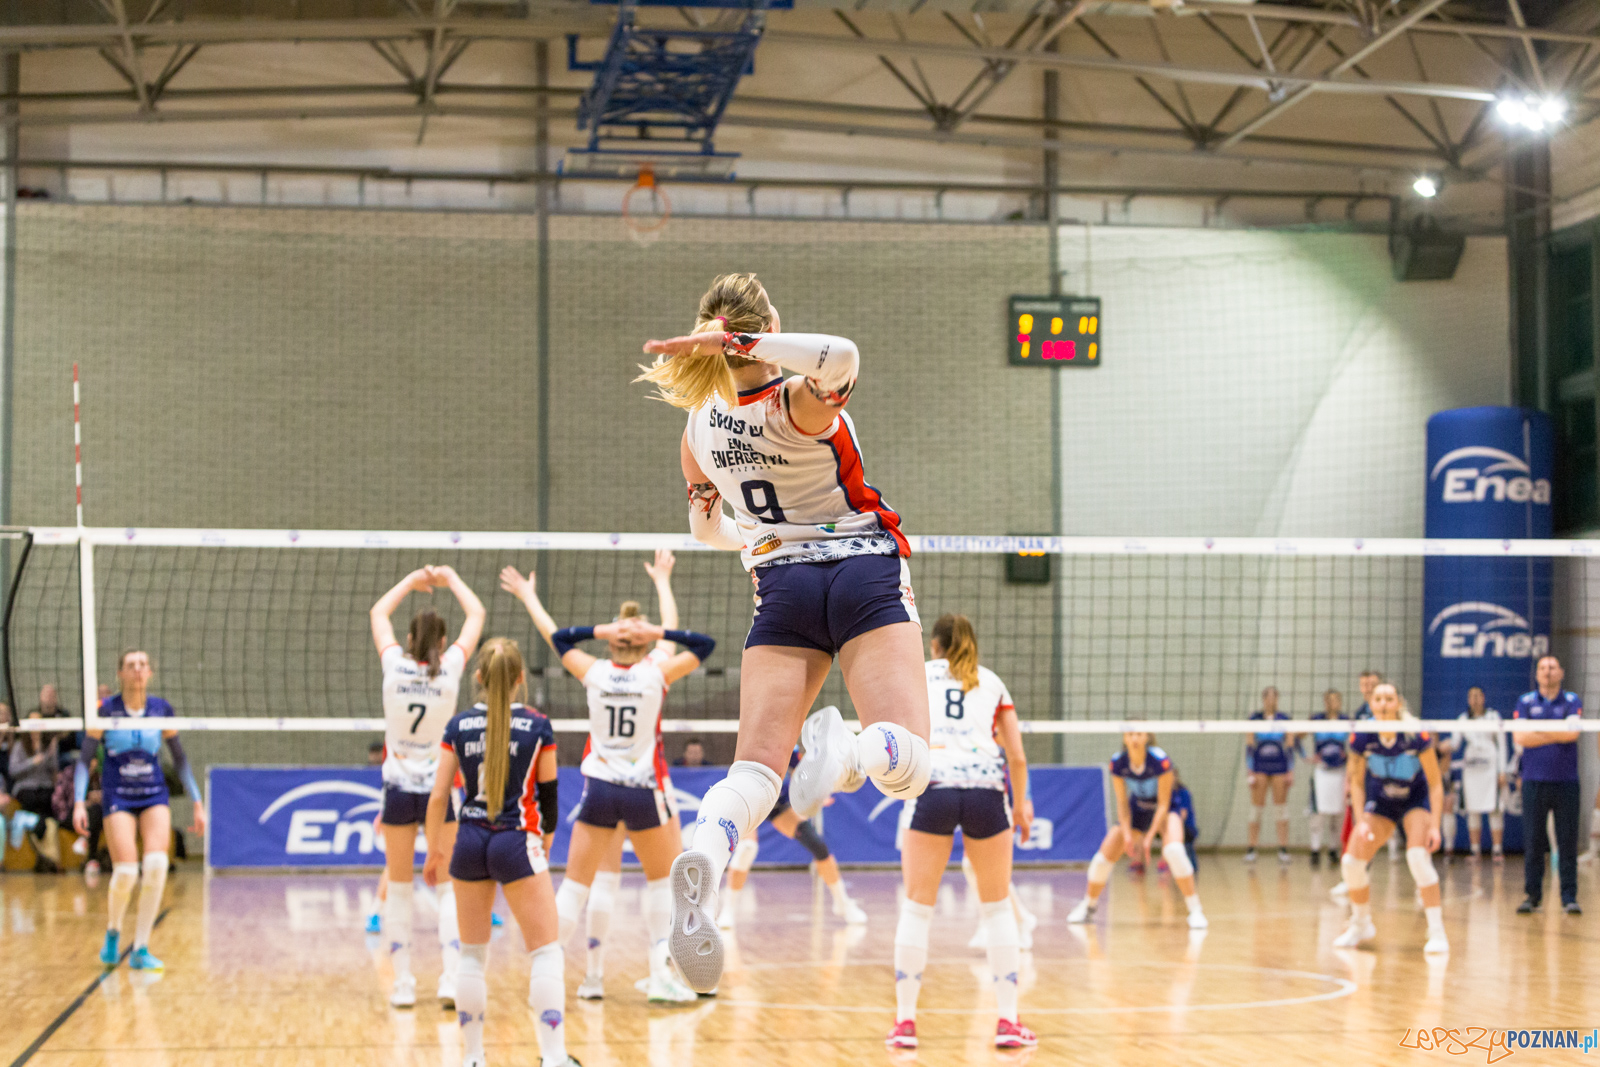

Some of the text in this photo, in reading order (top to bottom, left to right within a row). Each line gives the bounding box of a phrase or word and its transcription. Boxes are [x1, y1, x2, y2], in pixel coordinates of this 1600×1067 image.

[741, 479, 788, 524] 9
[1442, 467, 1551, 504] Enea
[1440, 623, 1550, 658] Enea
[407, 703, 427, 734] 7
[945, 688, 965, 720] 8
[604, 705, 637, 738] 16
